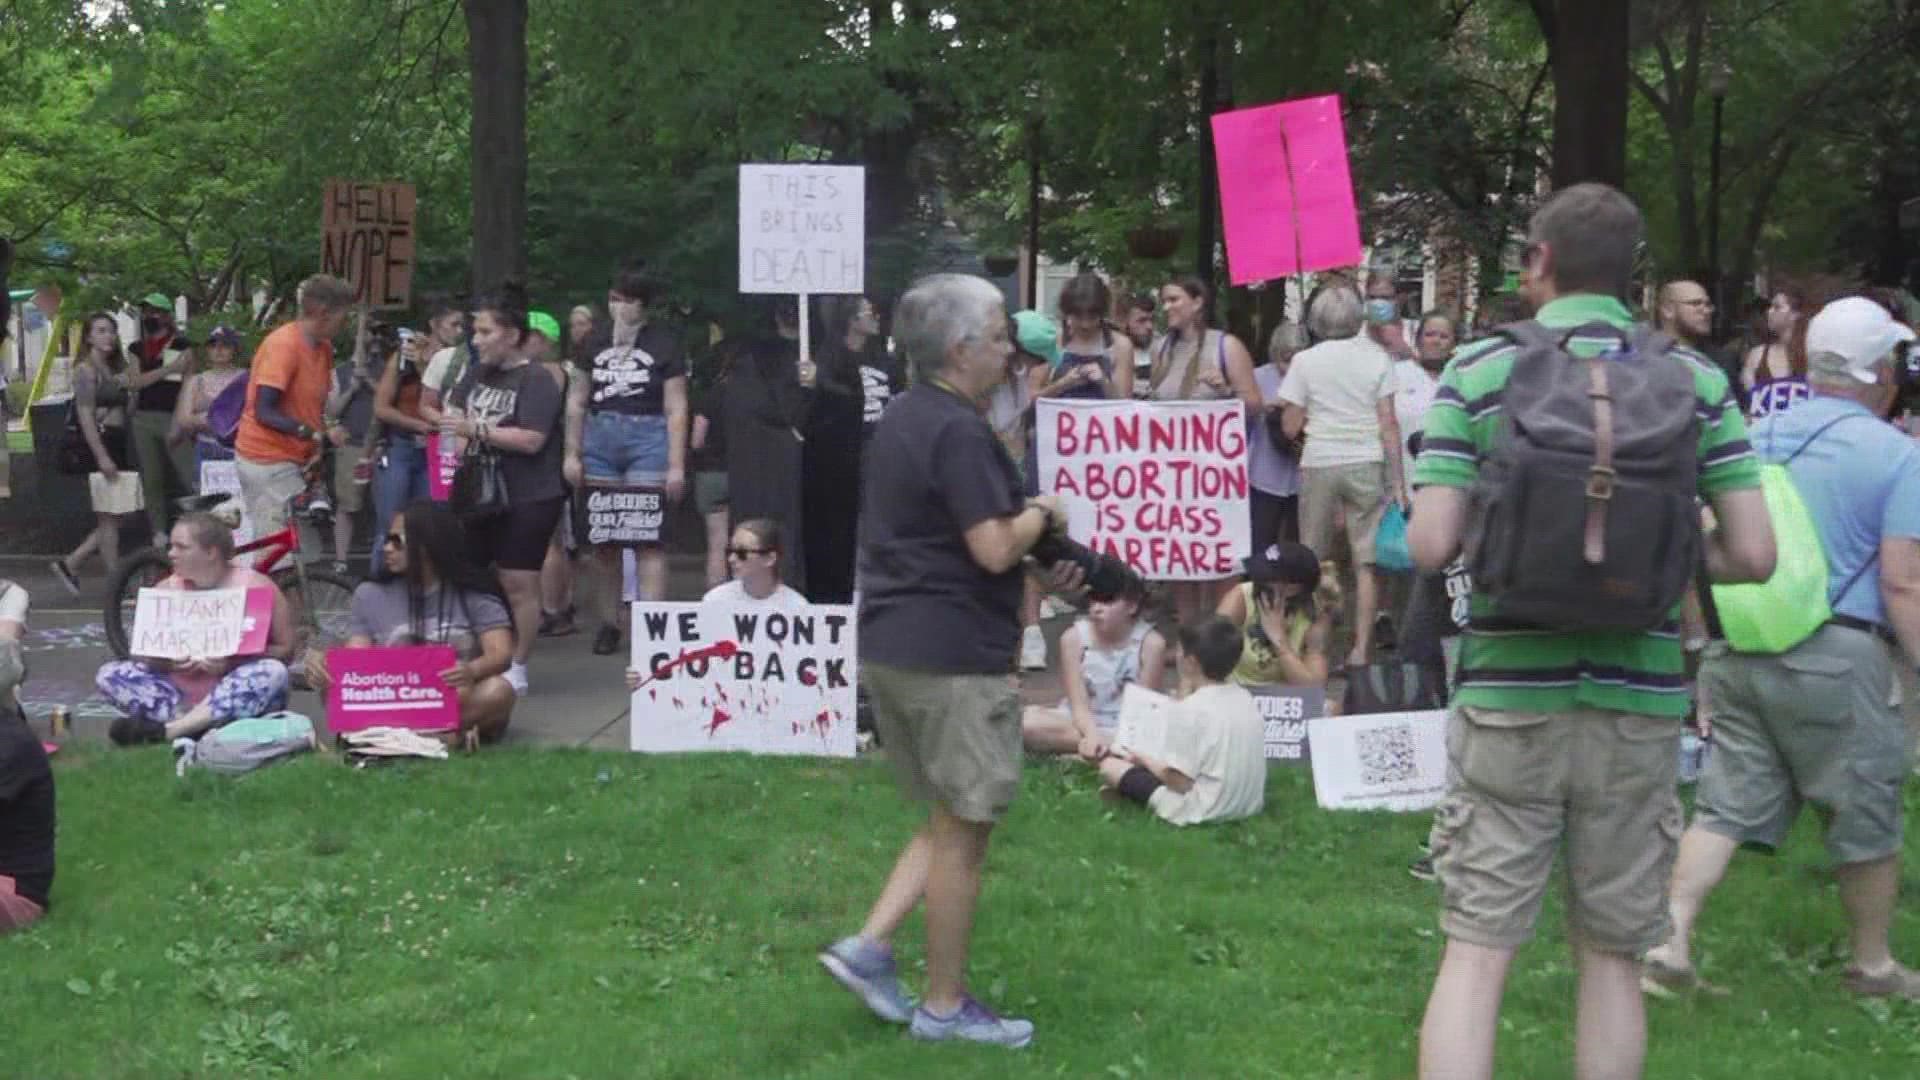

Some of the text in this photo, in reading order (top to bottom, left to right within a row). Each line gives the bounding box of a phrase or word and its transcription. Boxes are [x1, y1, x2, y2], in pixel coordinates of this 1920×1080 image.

[333, 184, 409, 225] HELL
[760, 174, 843, 201] THIS
[760, 208, 846, 234] BRINGS
[323, 228, 408, 304] NOPE
[751, 246, 859, 289] DEATH
[1057, 411, 1244, 459] BANNING
[1054, 460, 1246, 500] ABORTION
[1135, 503, 1222, 537] CLASS
[1090, 537, 1233, 577] ARFARE
[148, 595, 239, 619] THANKS
[140, 629, 232, 652] MARHA
[644, 612, 847, 645] WE WONT
[342, 671, 420, 686] Abortion is
[650, 651, 848, 688] GO BACK
[342, 686, 443, 701] Health Care.
